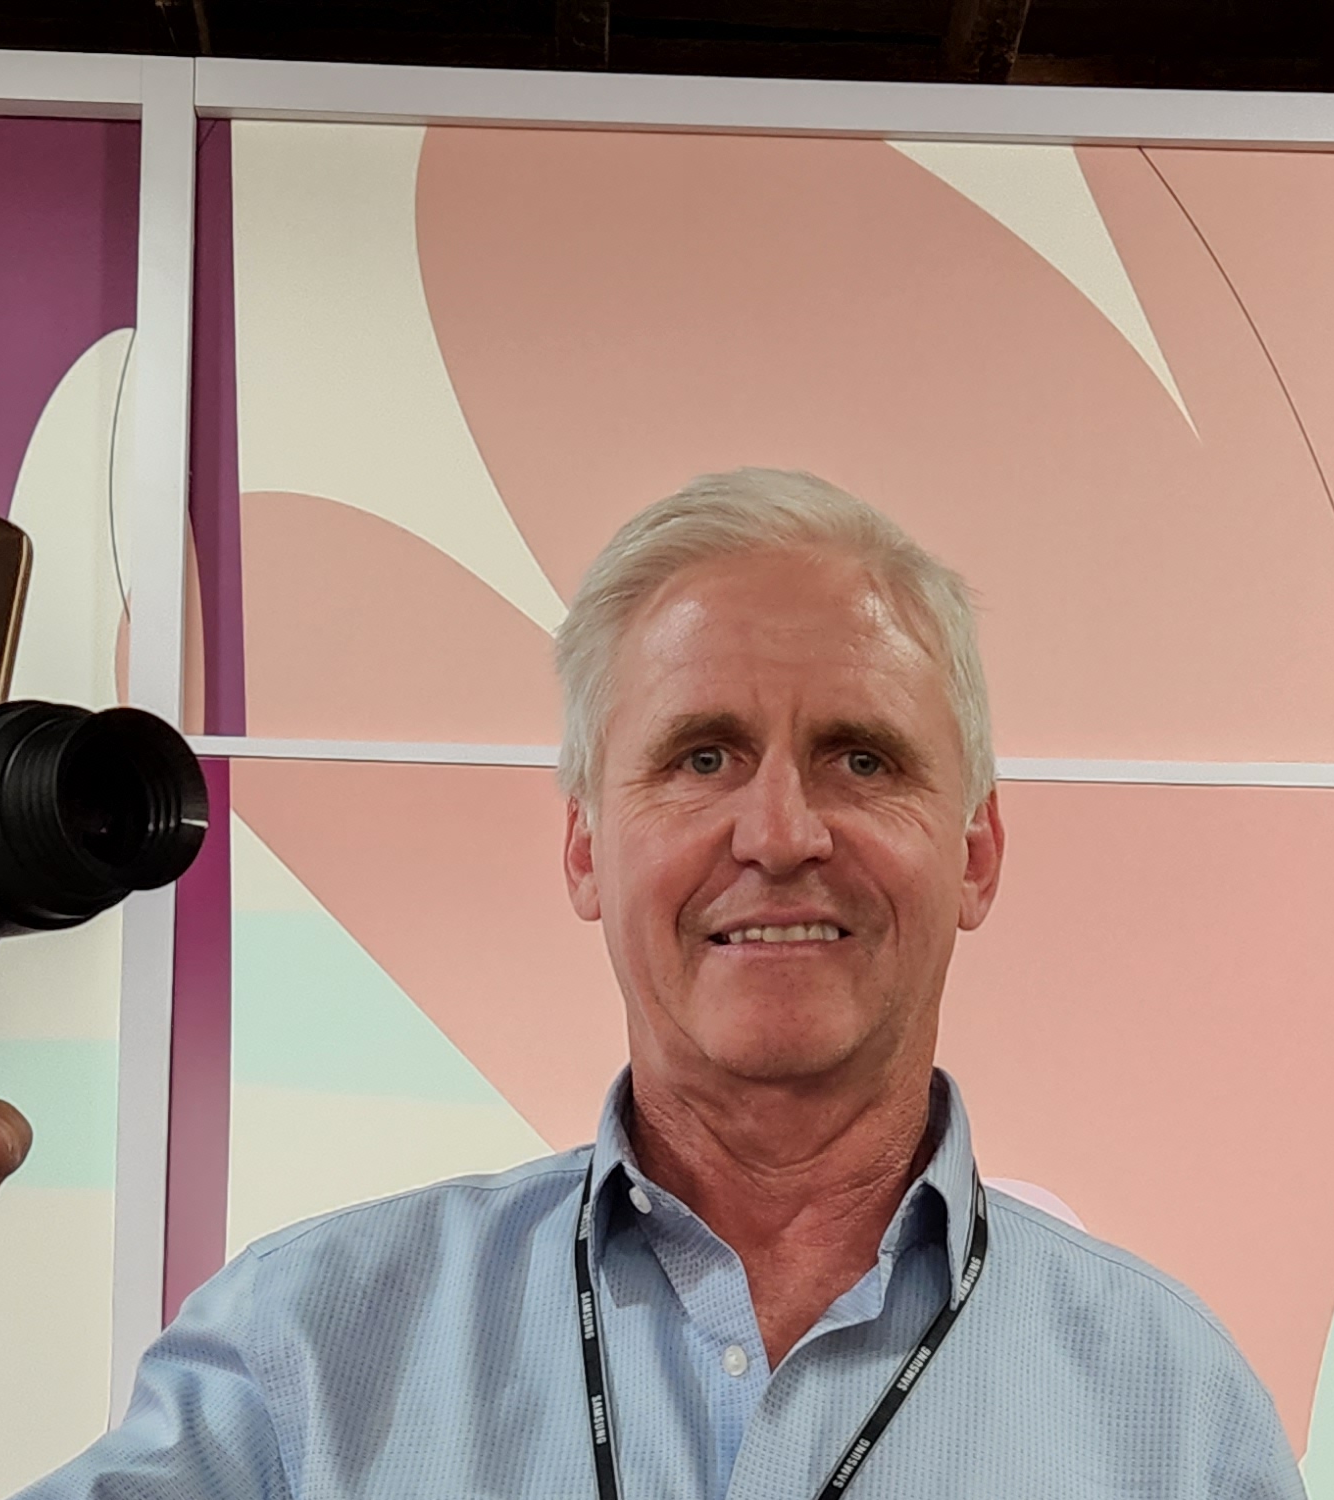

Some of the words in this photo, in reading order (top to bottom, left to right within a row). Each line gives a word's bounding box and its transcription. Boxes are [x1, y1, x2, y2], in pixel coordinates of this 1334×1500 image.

[581, 1291, 595, 1340] SAMSUNG
[896, 1346, 931, 1392] SAMSUNG
[591, 1395, 607, 1445] SAMSUNG
[832, 1438, 871, 1490] SAMSUNG
